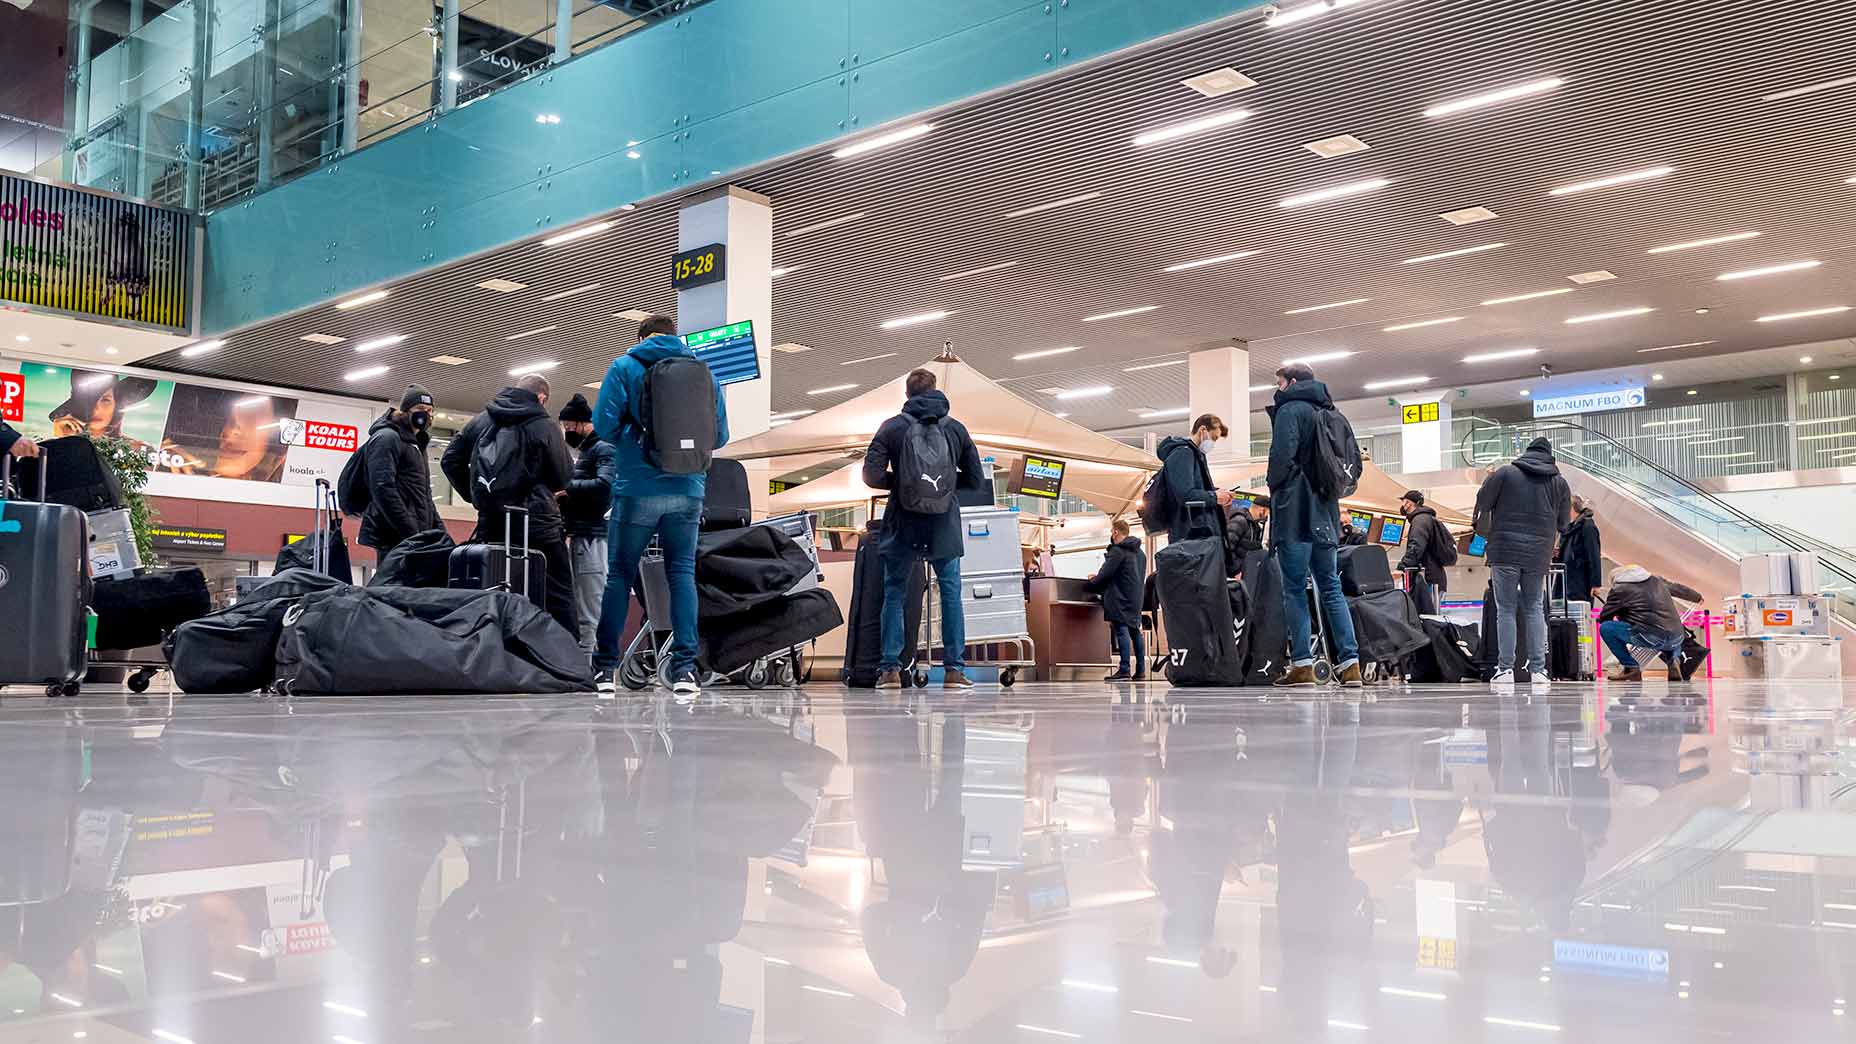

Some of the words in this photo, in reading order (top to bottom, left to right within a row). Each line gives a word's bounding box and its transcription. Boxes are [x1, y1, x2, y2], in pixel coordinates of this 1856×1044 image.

[674, 252, 714, 281] 15-28
[1536, 398, 1594, 413] MAGNUM
[1597, 395, 1621, 407] FBO
[308, 424, 356, 439] KOALA
[308, 436, 355, 449] TOURS
[1171, 648, 1189, 667] 27
